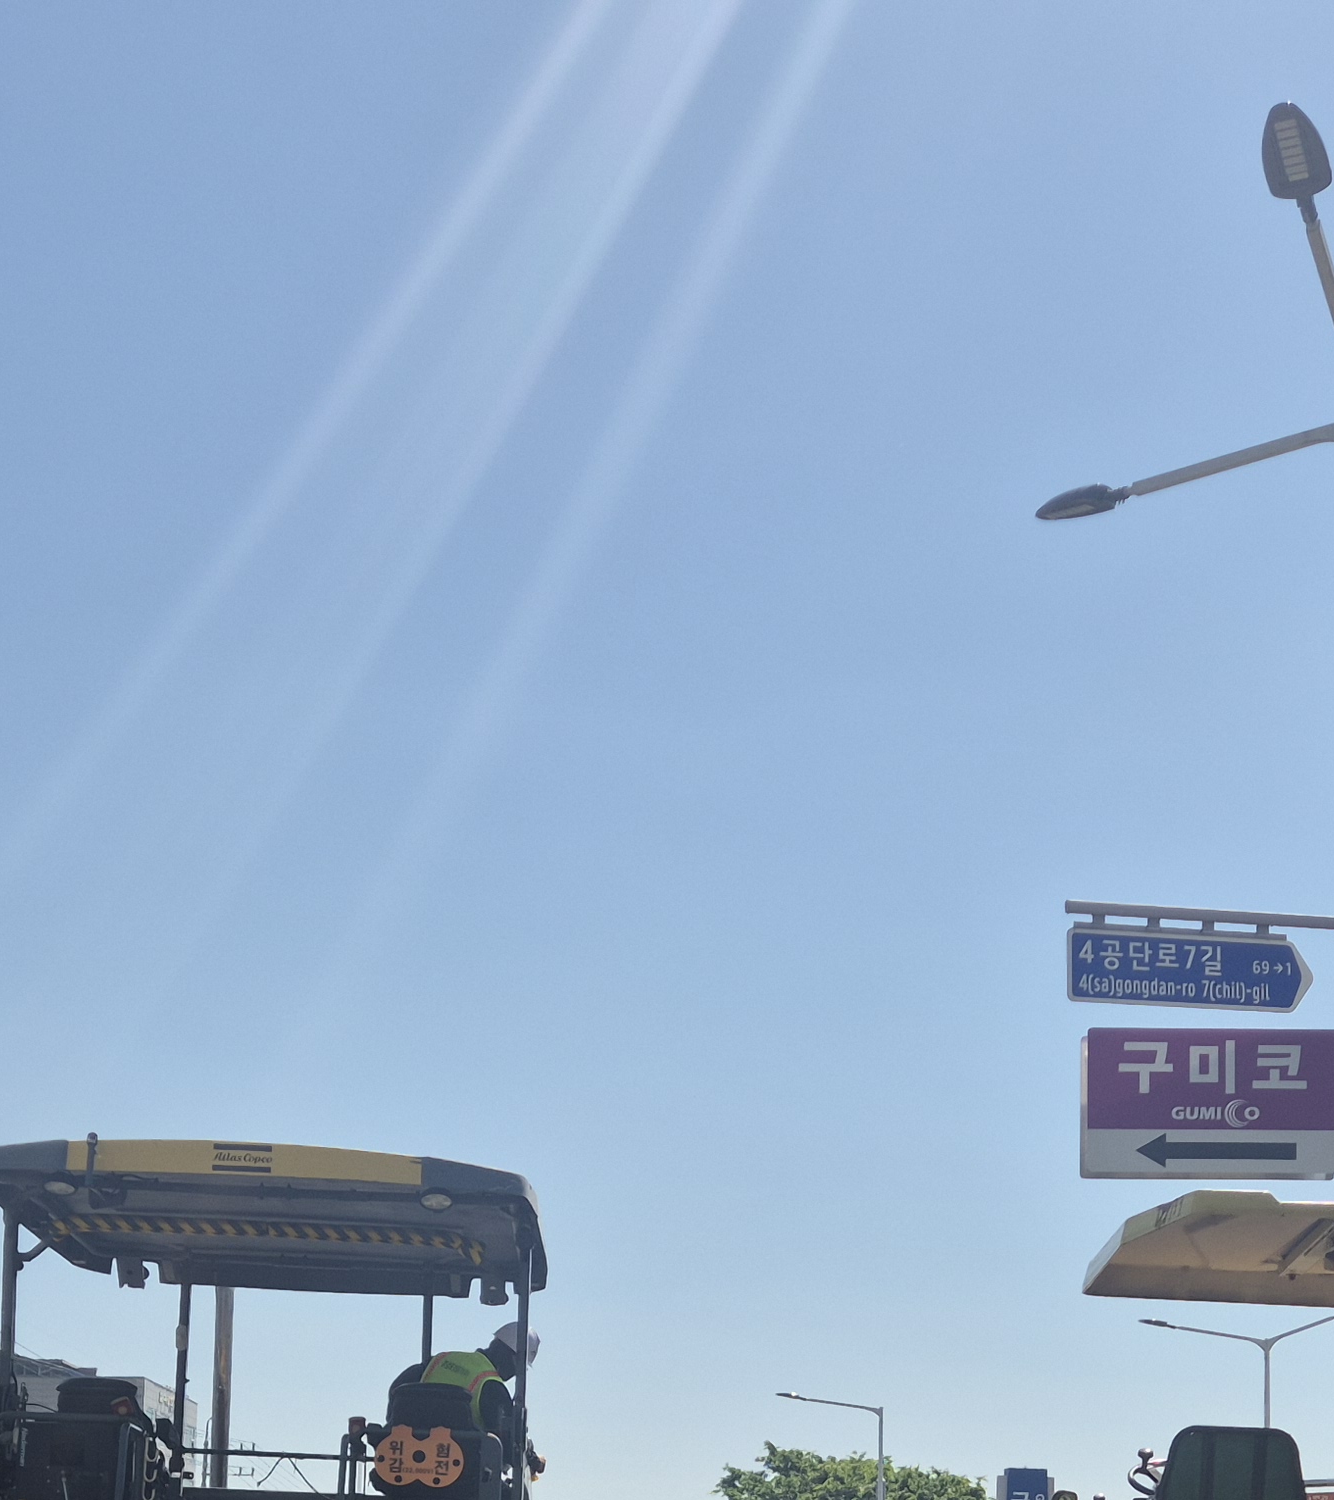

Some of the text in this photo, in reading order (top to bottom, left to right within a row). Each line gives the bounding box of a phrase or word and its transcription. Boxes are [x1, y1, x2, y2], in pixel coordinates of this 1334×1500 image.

[1078, 939, 1222, 977] 4공단로7길
[1078, 974, 1271, 1004] 4(sa)gongdan-ro 7(chil)-gil
[1118, 1039, 1308, 1095] 구미코
[213, 1152, 273, 1164] Atlas Copco
